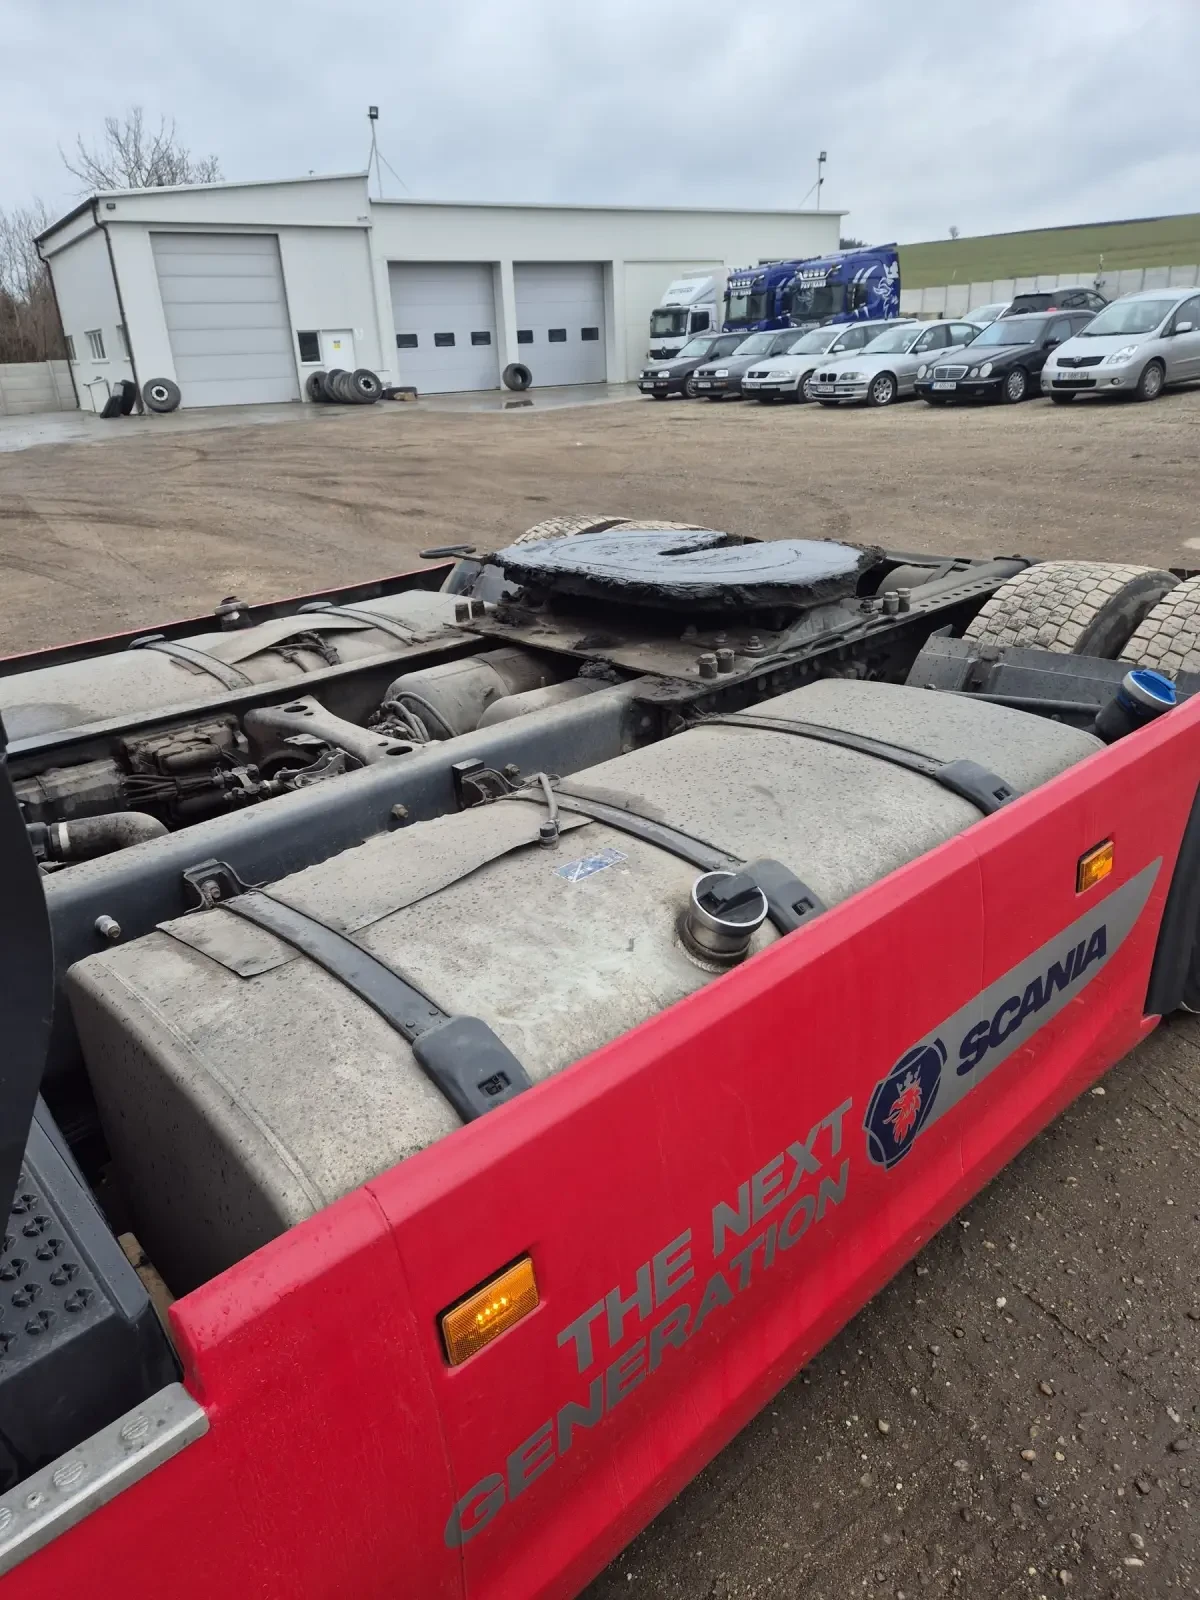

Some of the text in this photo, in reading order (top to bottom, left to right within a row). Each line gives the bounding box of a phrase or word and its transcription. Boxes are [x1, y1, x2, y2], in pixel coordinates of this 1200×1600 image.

[956, 924, 1107, 1077] SCANIA
[444, 1157, 850, 1549] GENERATION
[557, 1097, 853, 1374] THE NEXT
